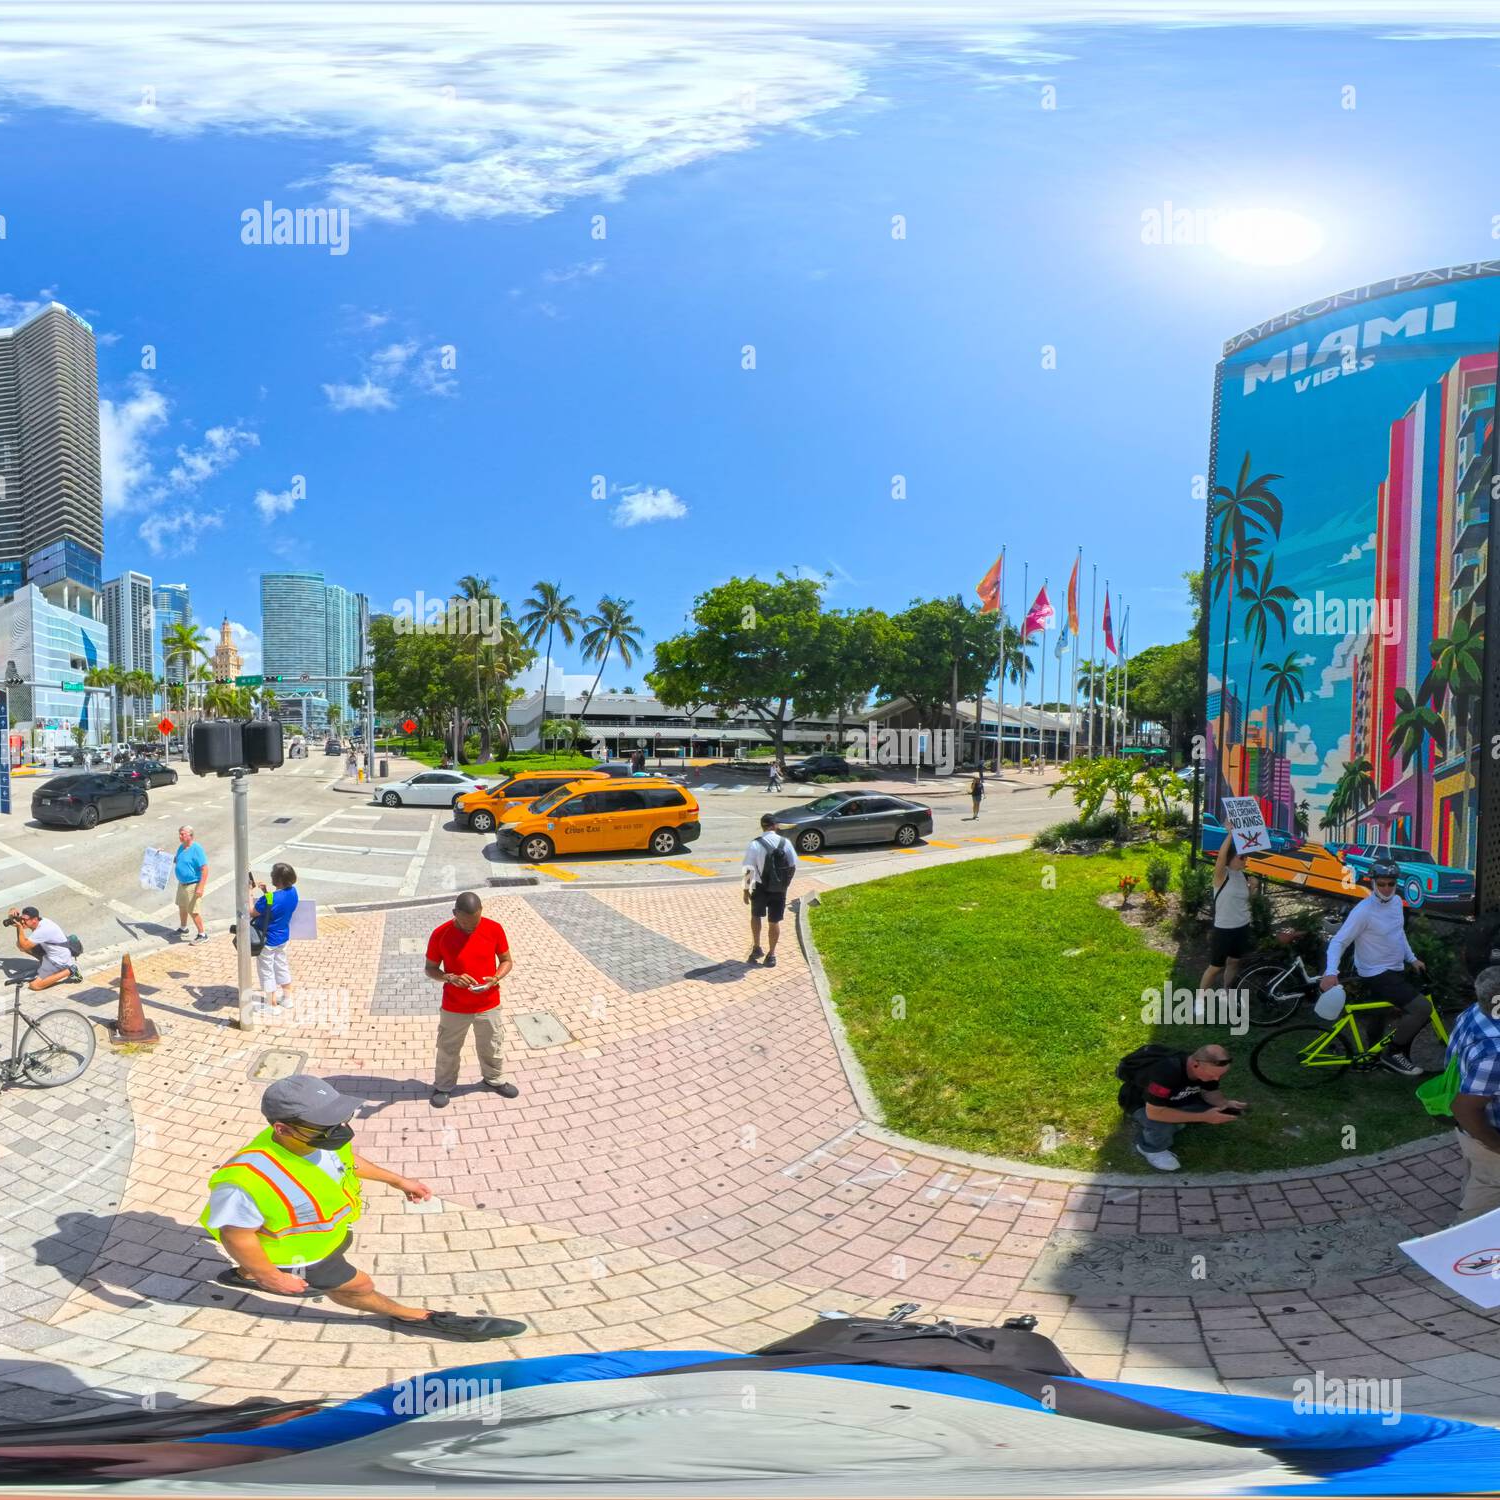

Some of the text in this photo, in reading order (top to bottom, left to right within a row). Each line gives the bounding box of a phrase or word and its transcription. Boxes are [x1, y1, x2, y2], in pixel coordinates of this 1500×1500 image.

[1223, 260, 1500, 353] BAYFRONT PARK
[1243, 301, 1457, 396] MIAMI
[1294, 354, 1375, 394] VIBES
[1228, 809, 1237, 817] NO
[1230, 815, 1263, 829] NO KINGS
